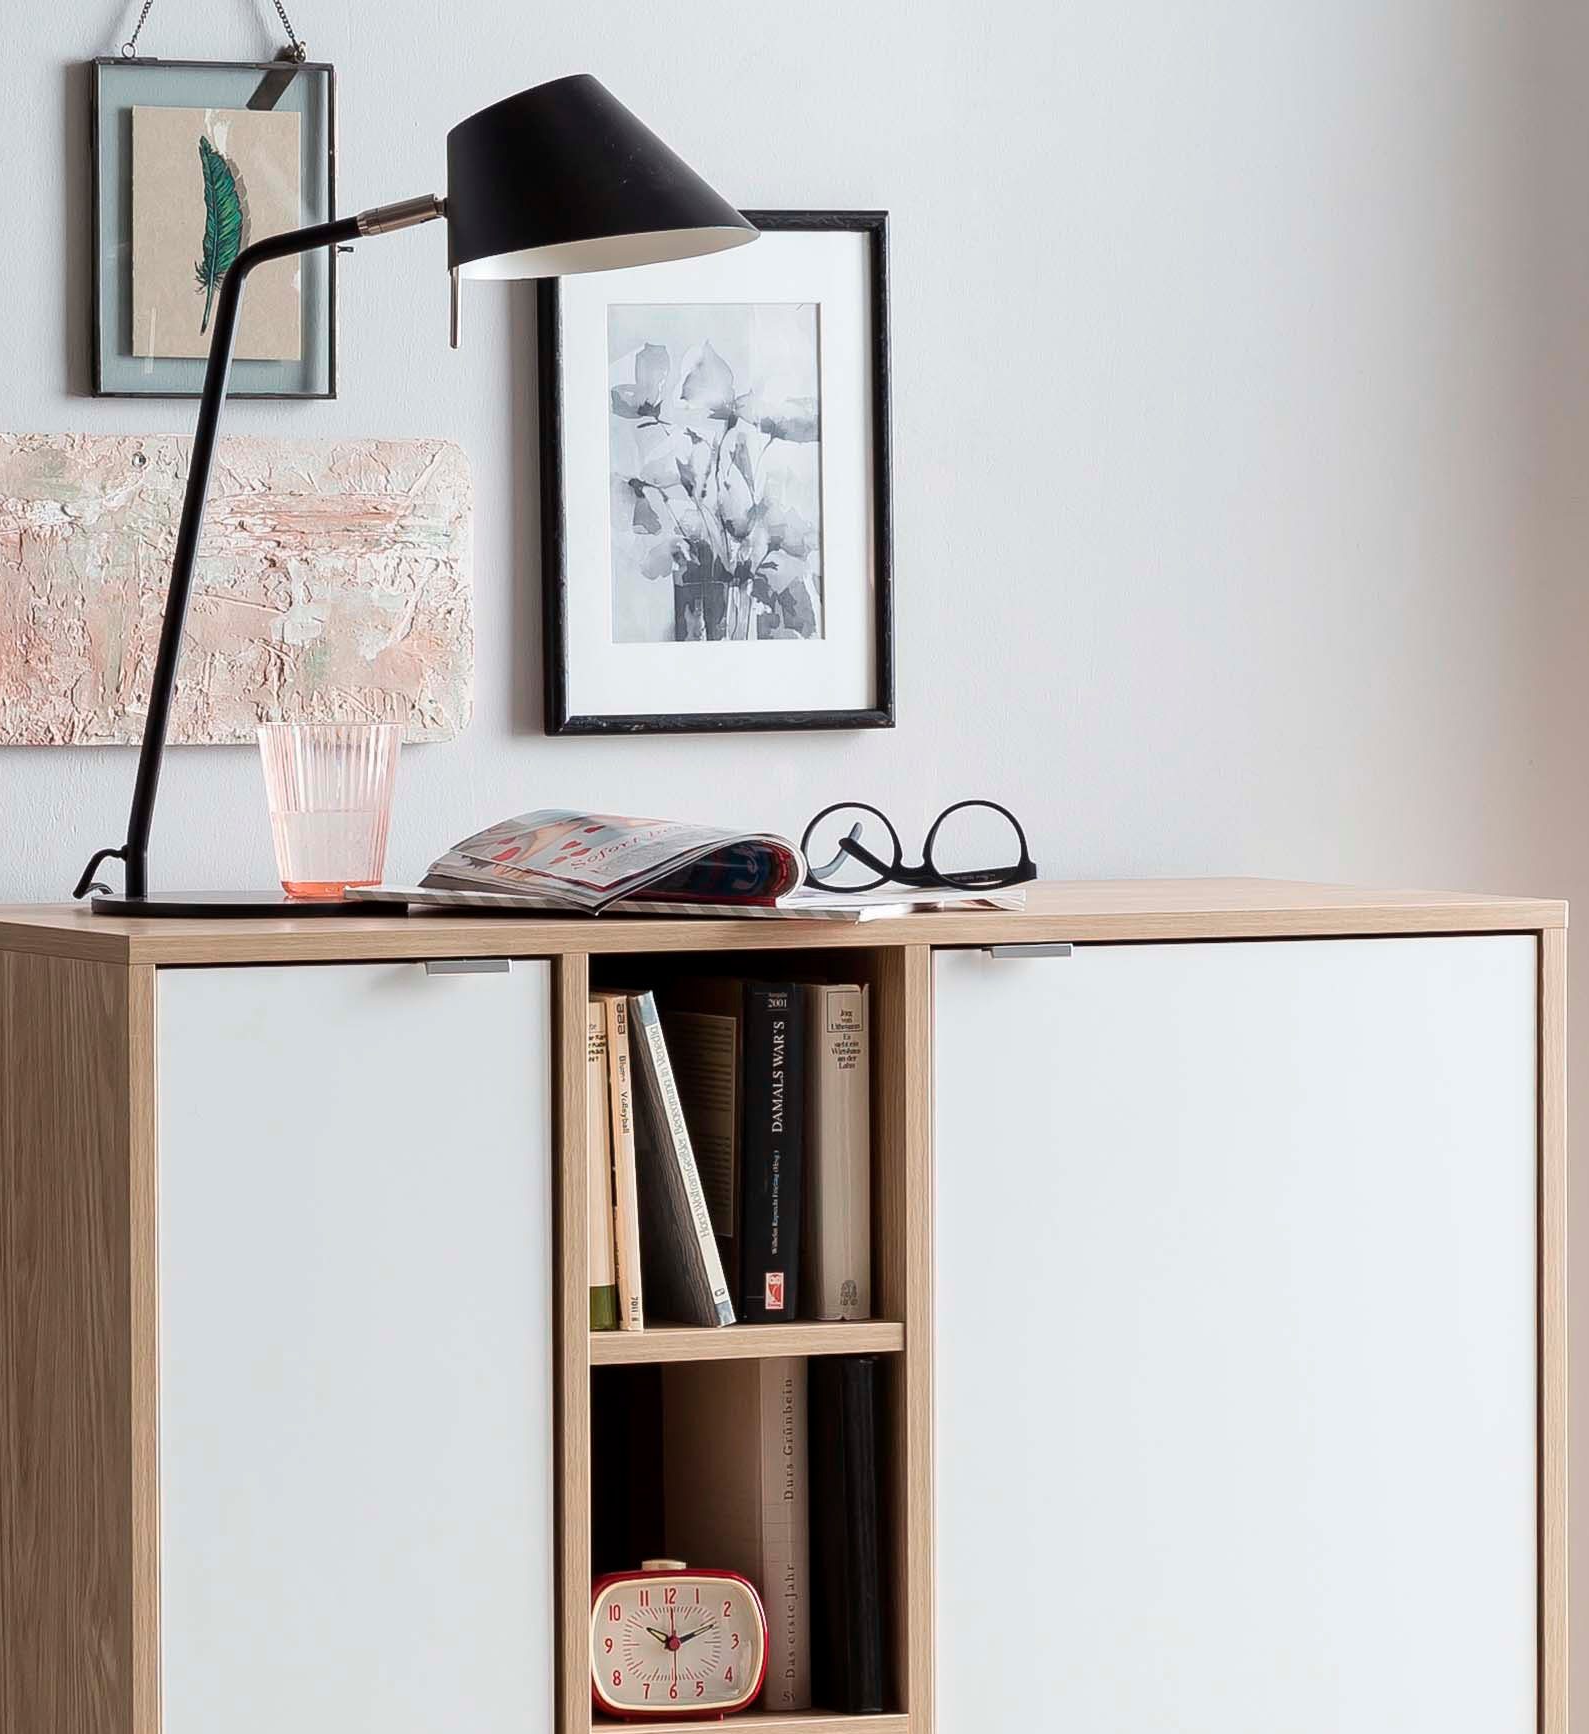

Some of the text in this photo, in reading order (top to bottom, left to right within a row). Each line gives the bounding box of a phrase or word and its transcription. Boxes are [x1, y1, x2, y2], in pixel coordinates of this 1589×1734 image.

[767, 998, 787, 1008] 2001
[771, 1070, 785, 1133] DAMALS
[782, 1379, 794, 1501] Durs Grünbein
[784, 1564, 798, 1600] Jahr
[640, 1590, 649, 1607] 11
[664, 1588, 677, 1604] 12
[695, 1588, 700, 1604] 1
[609, 1604, 621, 1621] 10
[723, 1601, 732, 1617] 2
[786, 1604, 796, 1645] erste
[604, 1638, 613, 1654] 9
[731, 1633, 740, 1650] 3
[784, 1650, 796, 1679] Das
[612, 1670, 622, 1686] 8
[724, 1666, 733, 1682] 4
[642, 1683, 651, 1700] 7
[669, 1683, 678, 1699] 6
[696, 1681, 704, 1697] 5
